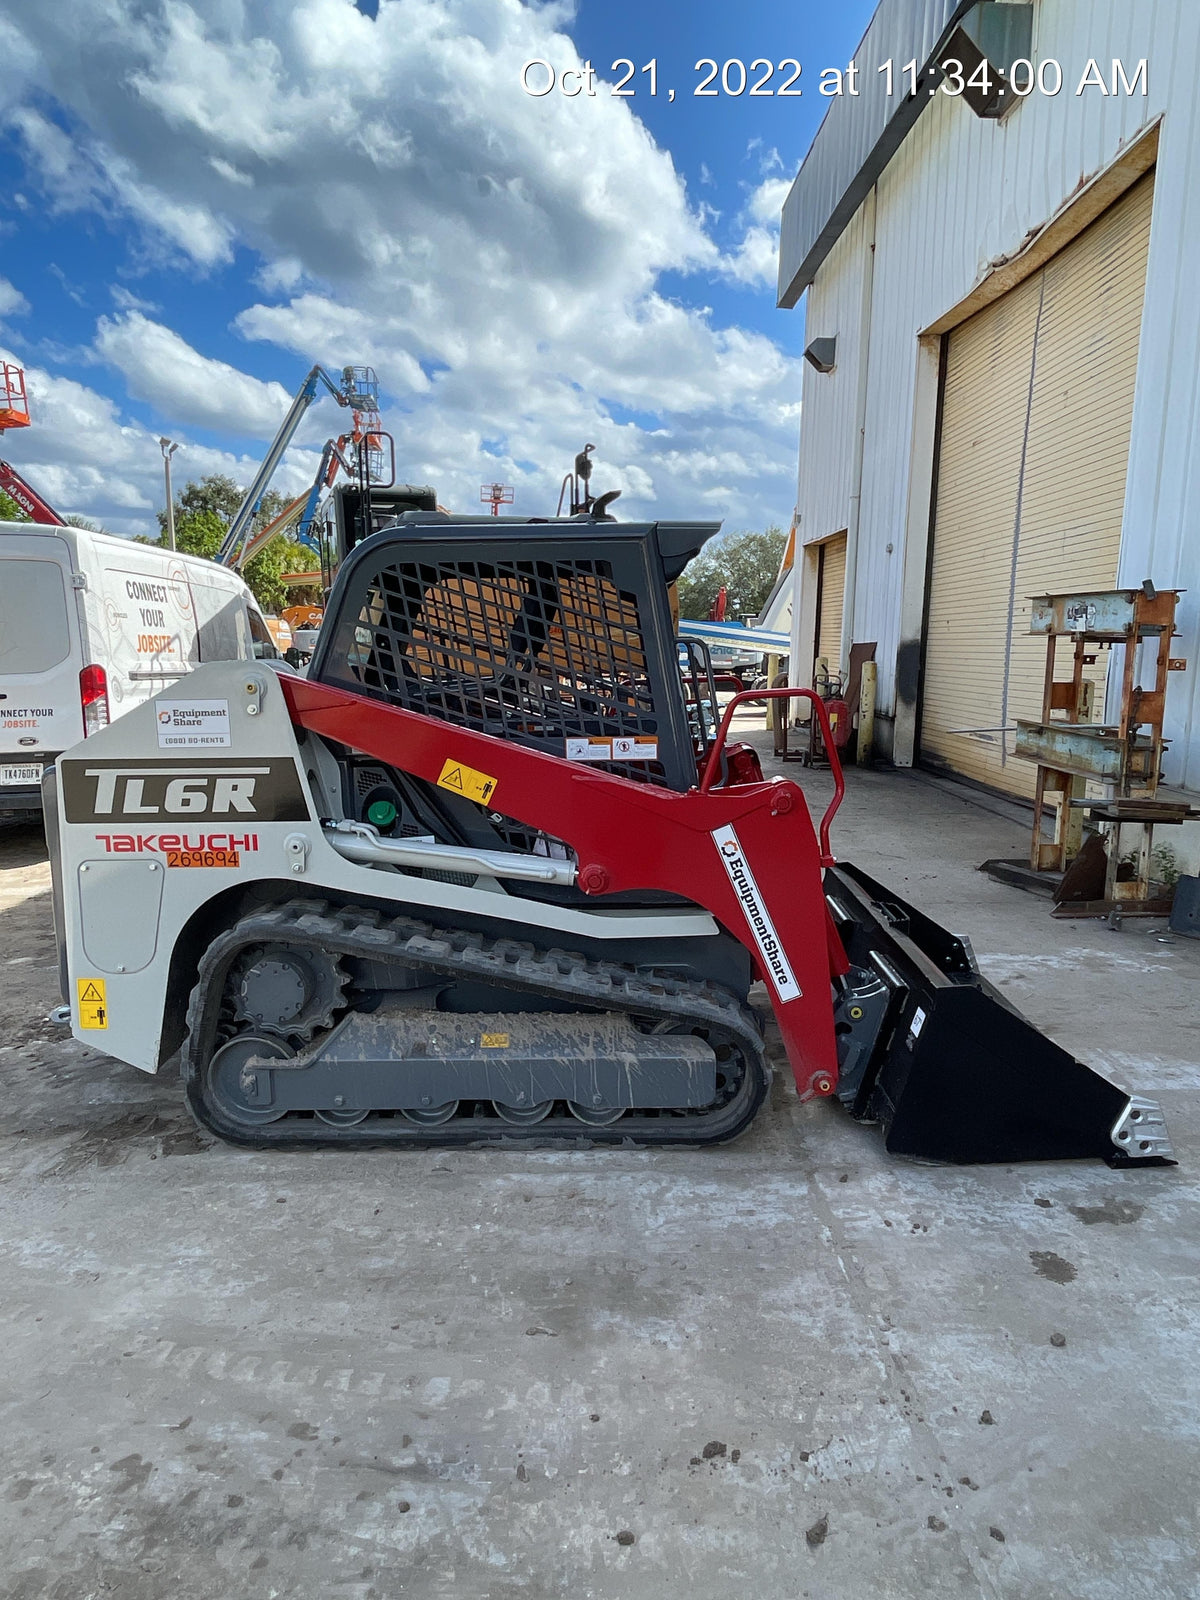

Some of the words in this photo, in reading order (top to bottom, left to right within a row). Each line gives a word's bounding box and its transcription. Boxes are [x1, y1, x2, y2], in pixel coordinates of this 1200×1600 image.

[7, 485, 35, 512] MAGNI
[125, 580, 168, 603] CONNECT
[139, 608, 165, 628] YOUR
[137, 634, 175, 653] JOBSITE.
[30, 708, 54, 717] YOUR
[172, 709, 227, 718] Equipment
[173, 718, 202, 726] Share
[84, 767, 271, 814] TL6R
[168, 851, 239, 868] 269694
[729, 857, 788, 985] EquipmentShare
